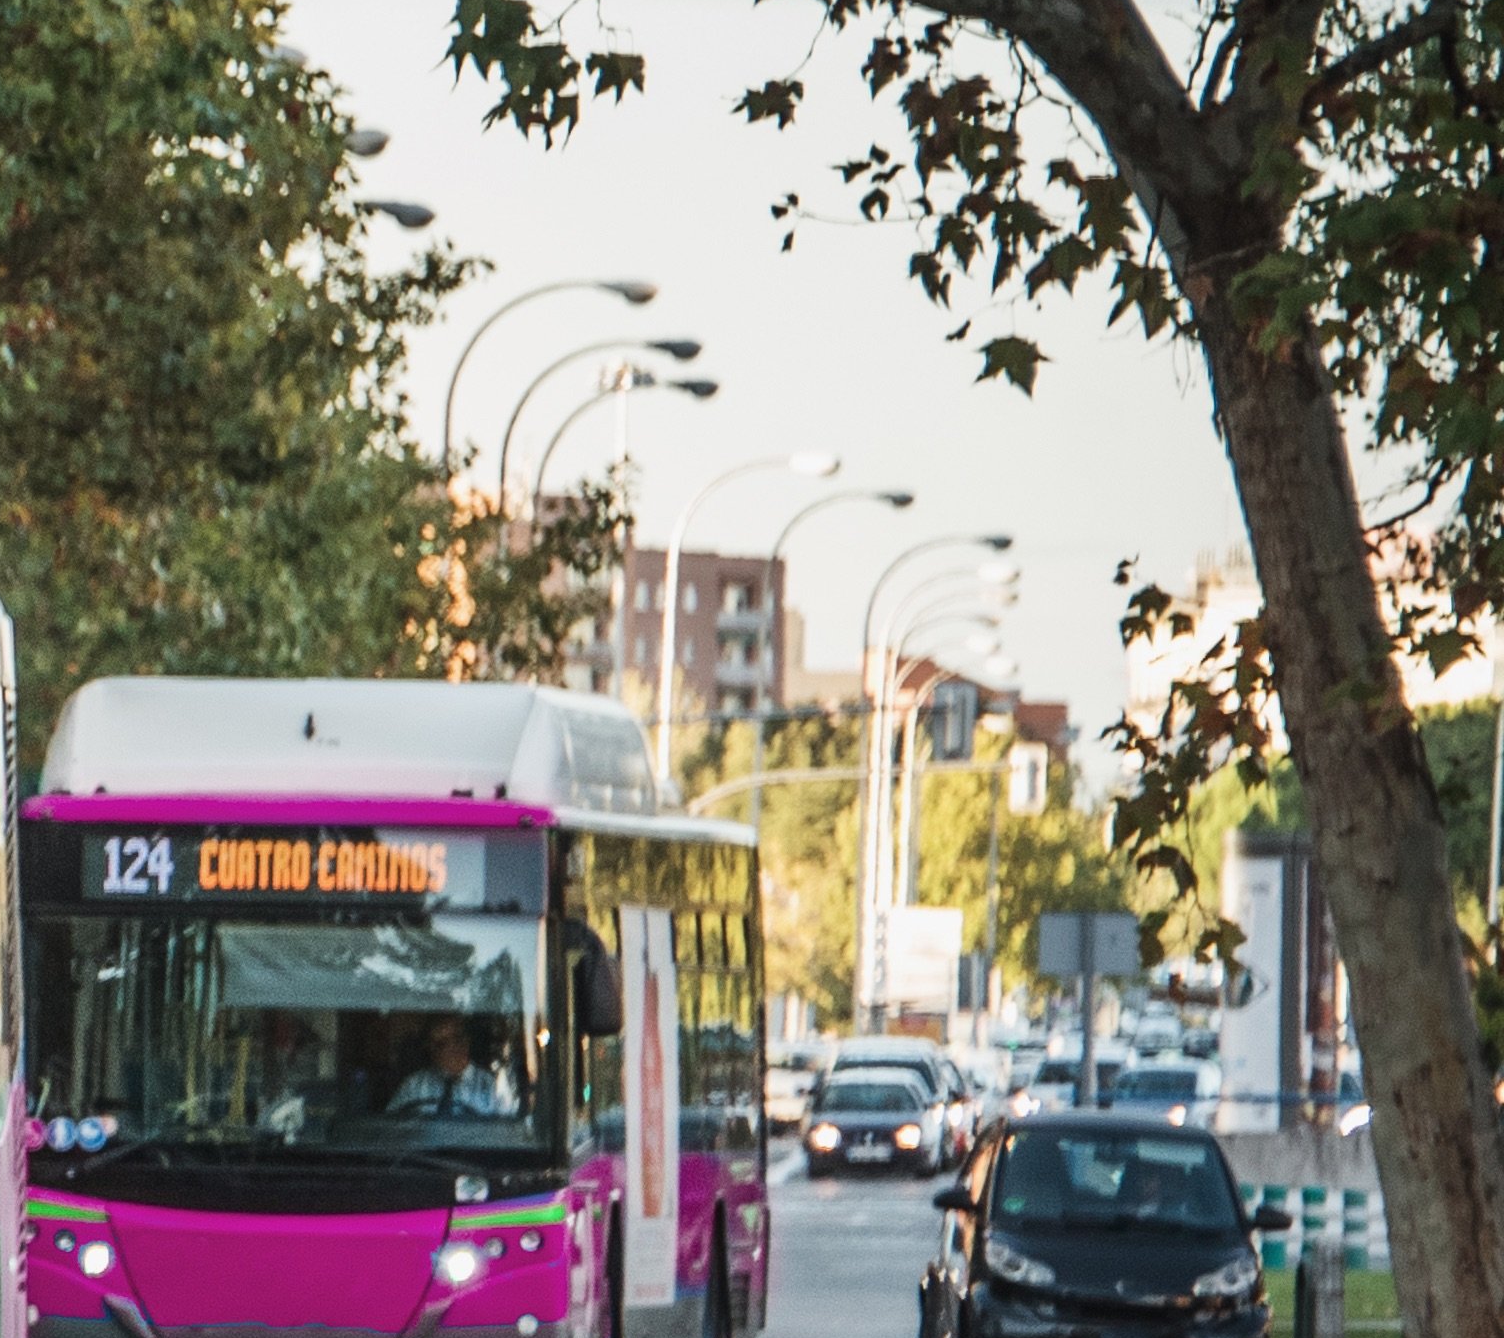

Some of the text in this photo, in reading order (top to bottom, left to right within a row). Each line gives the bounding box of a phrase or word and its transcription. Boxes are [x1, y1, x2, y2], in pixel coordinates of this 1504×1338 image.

[103, 836, 449, 895] 124 CUATRO CAMINOS
